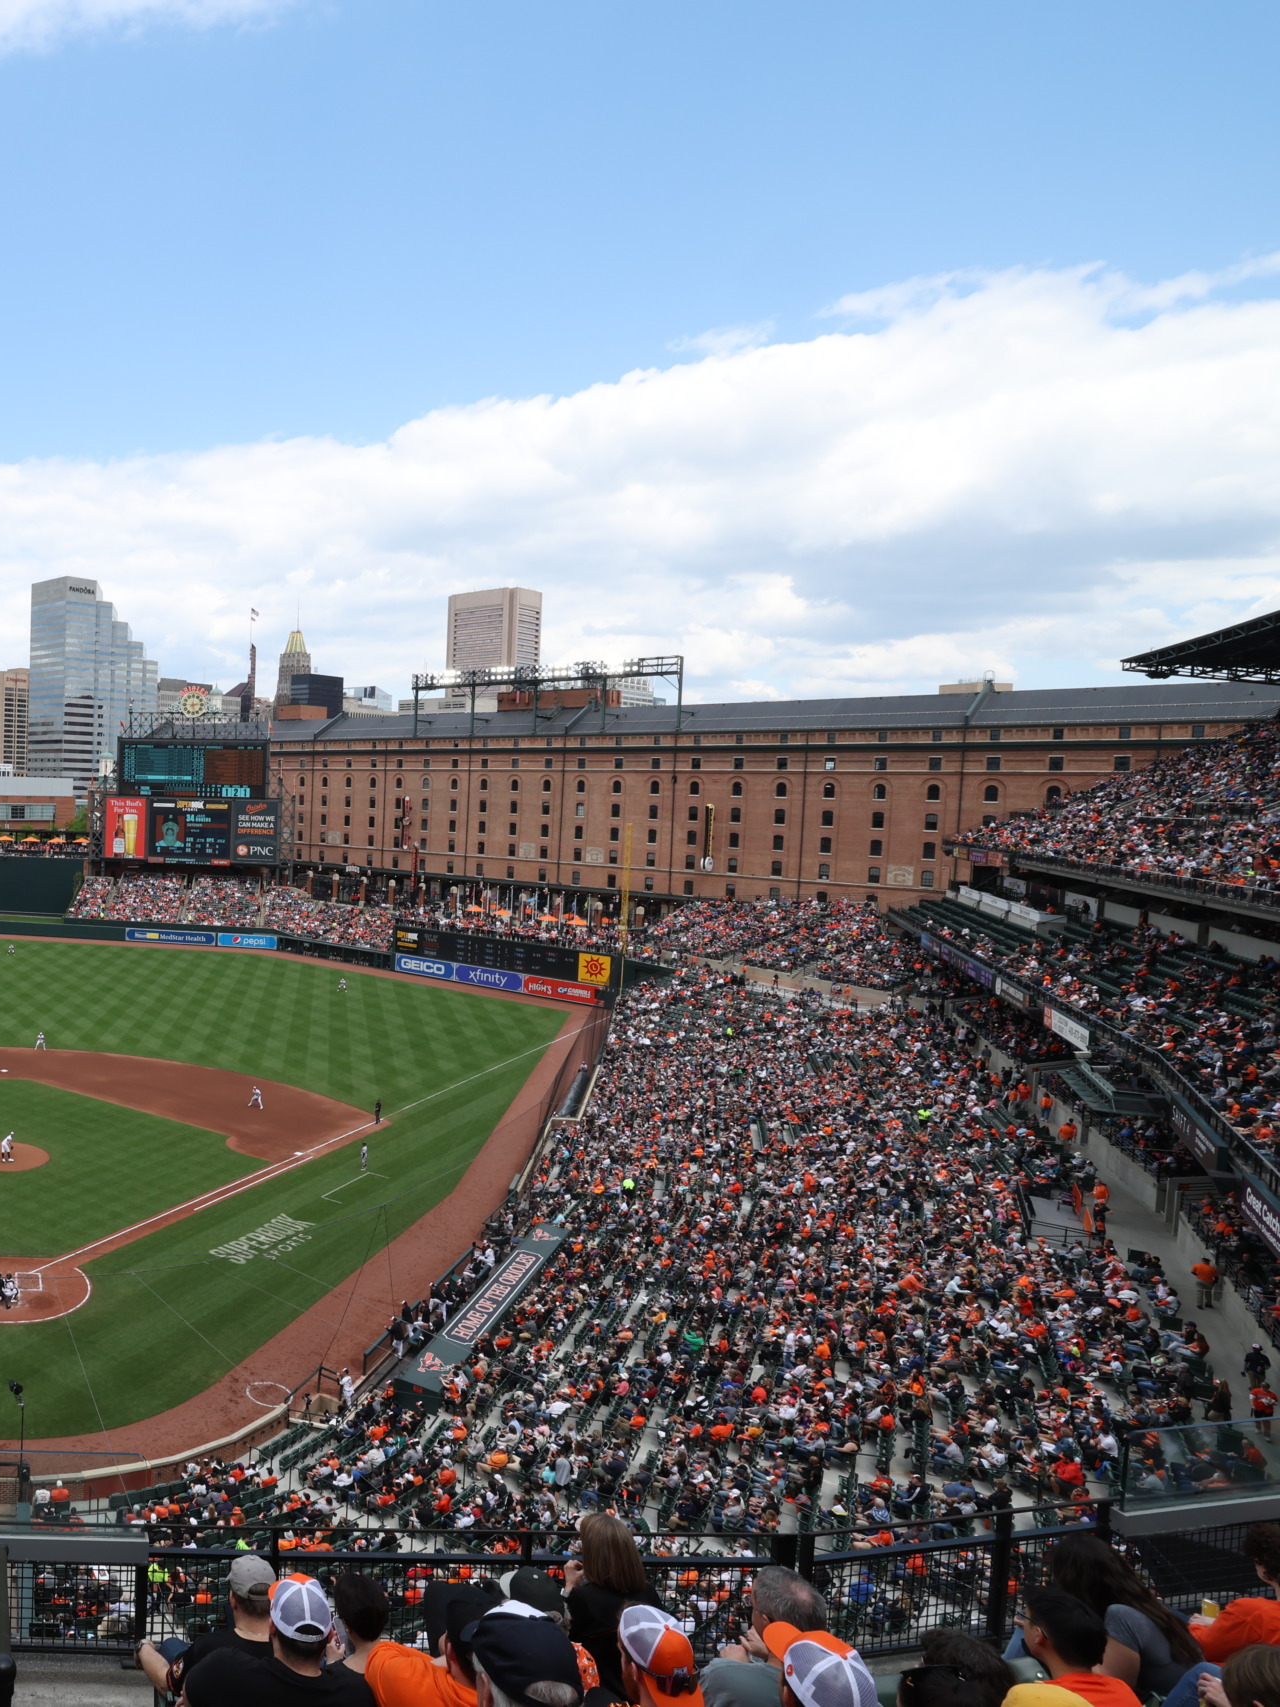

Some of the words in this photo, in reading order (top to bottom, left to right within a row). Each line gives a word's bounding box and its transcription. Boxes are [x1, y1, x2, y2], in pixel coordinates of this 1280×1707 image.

[69, 586, 95, 595] PANDORA
[179, 685, 209, 696] ORIOLES
[233, 788, 238, 797] 2
[245, 803, 268, 814] Orioles
[186, 814, 194, 822] 34
[250, 845, 274, 856] PNC
[160, 933, 185, 941] MedStar
[243, 937, 266, 946] pepsi
[401, 958, 445, 975] GEICO
[469, 969, 508, 987] xfinity
[528, 982, 552, 994] HIGH'S
[1172, 1105, 1187, 1133] SHIFT
[1246, 1187, 1262, 1216] Great
[209, 1213, 316, 1264] SUPERBOOK
[263, 1233, 312, 1260] SPORTS
[498, 1253, 536, 1285] ORIOLES
[484, 1282, 511, 1301] THE
[475, 1298, 497, 1313] OF
[451, 1310, 488, 1340] HOME
